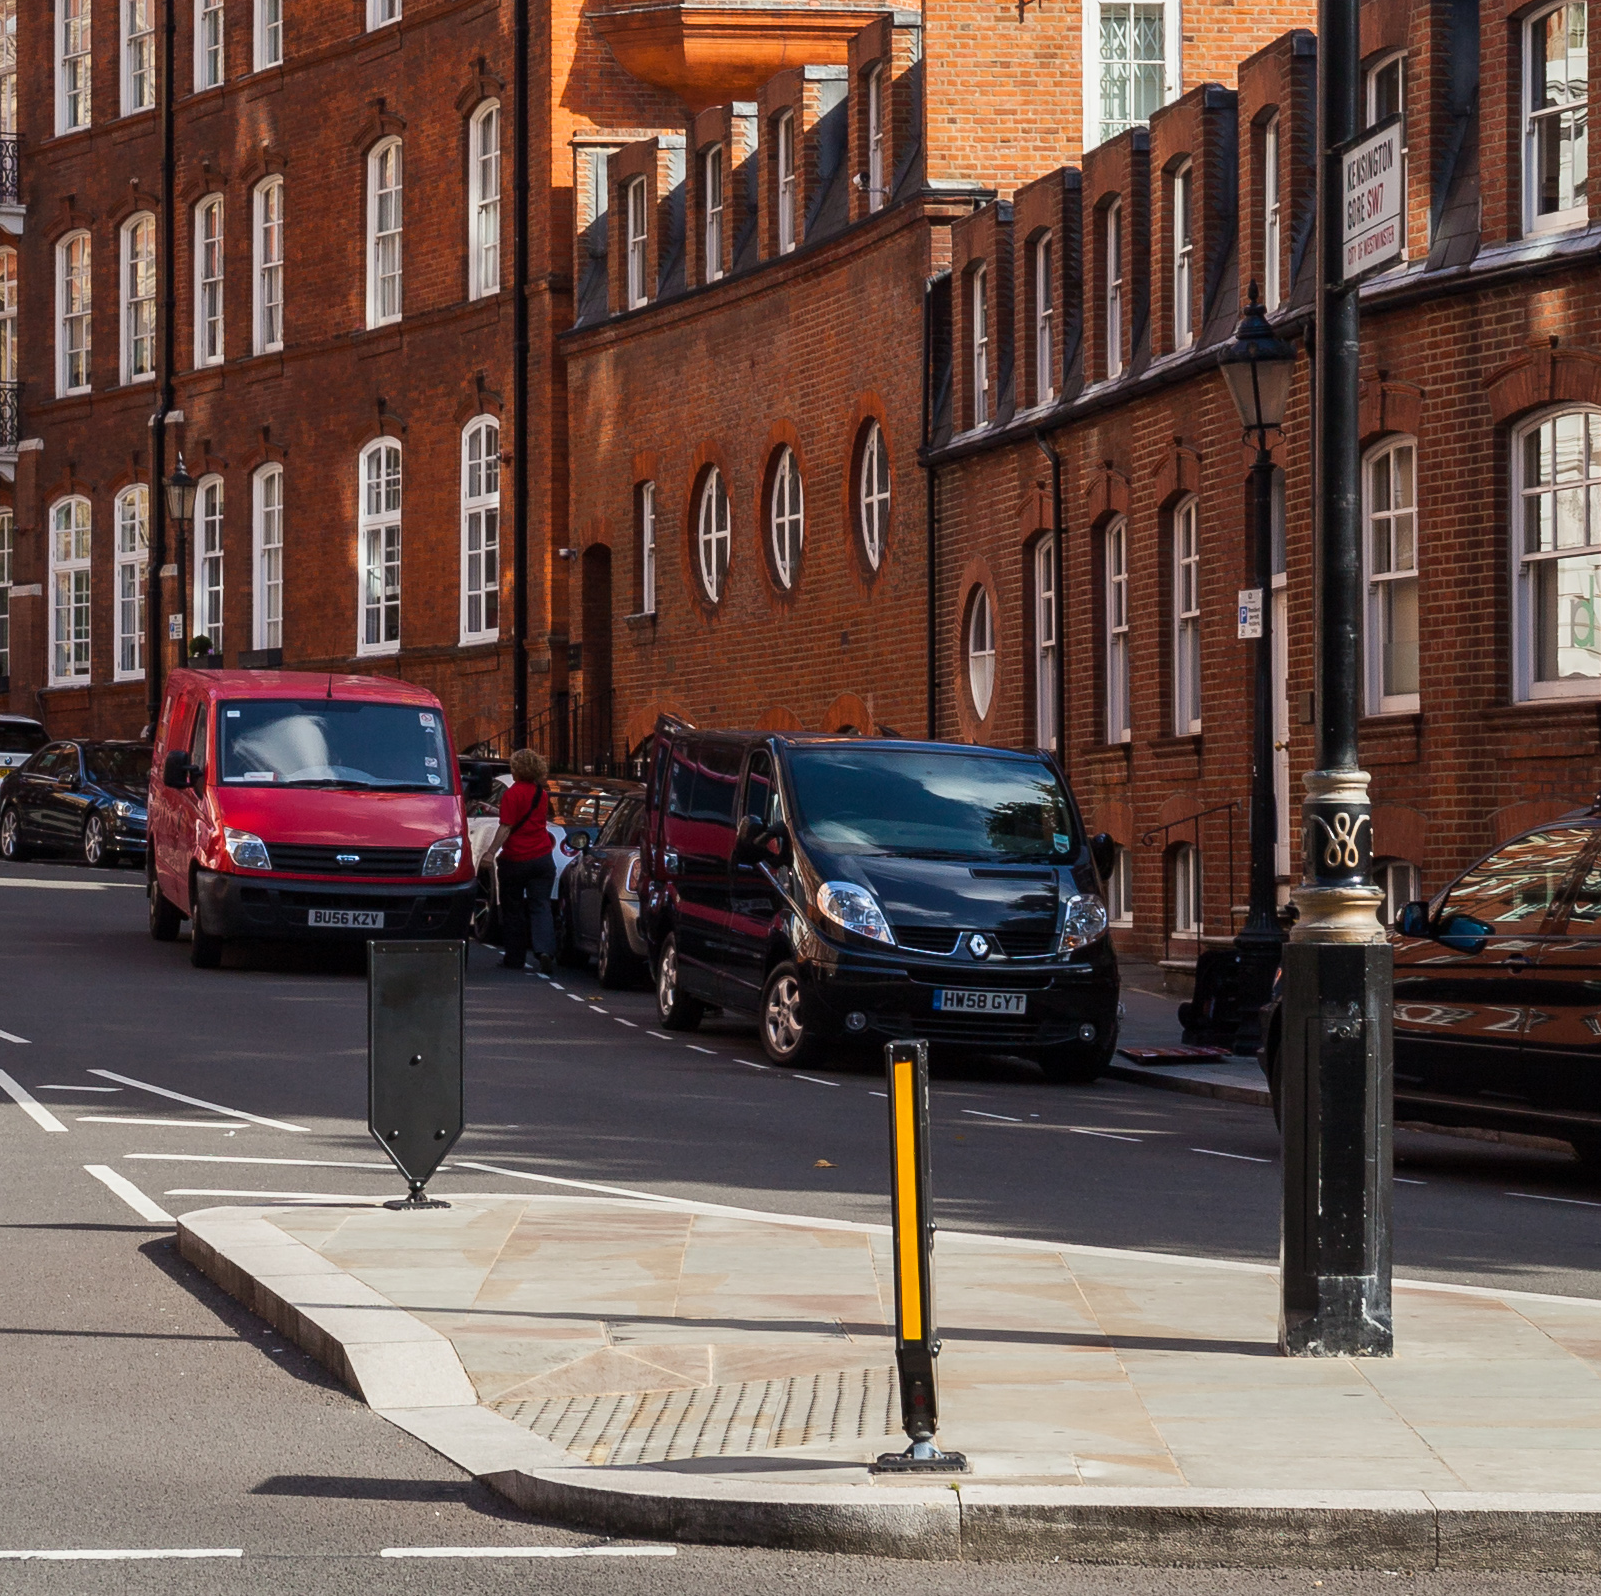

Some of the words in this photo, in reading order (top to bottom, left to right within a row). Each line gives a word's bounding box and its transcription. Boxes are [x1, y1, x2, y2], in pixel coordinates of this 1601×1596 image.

[1347, 138, 1393, 193] KENSINGTON
[1347, 193, 1365, 230] GORE
[1367, 182, 1384, 219] SW7
[1348, 243, 1356, 265] CITY
[1364, 224, 1395, 255] WESTMINSTER
[314, 910, 349, 925] BU56
[352, 912, 378, 926] KZV
[943, 991, 988, 1009] HW58
[992, 993, 1024, 1011] GYT
